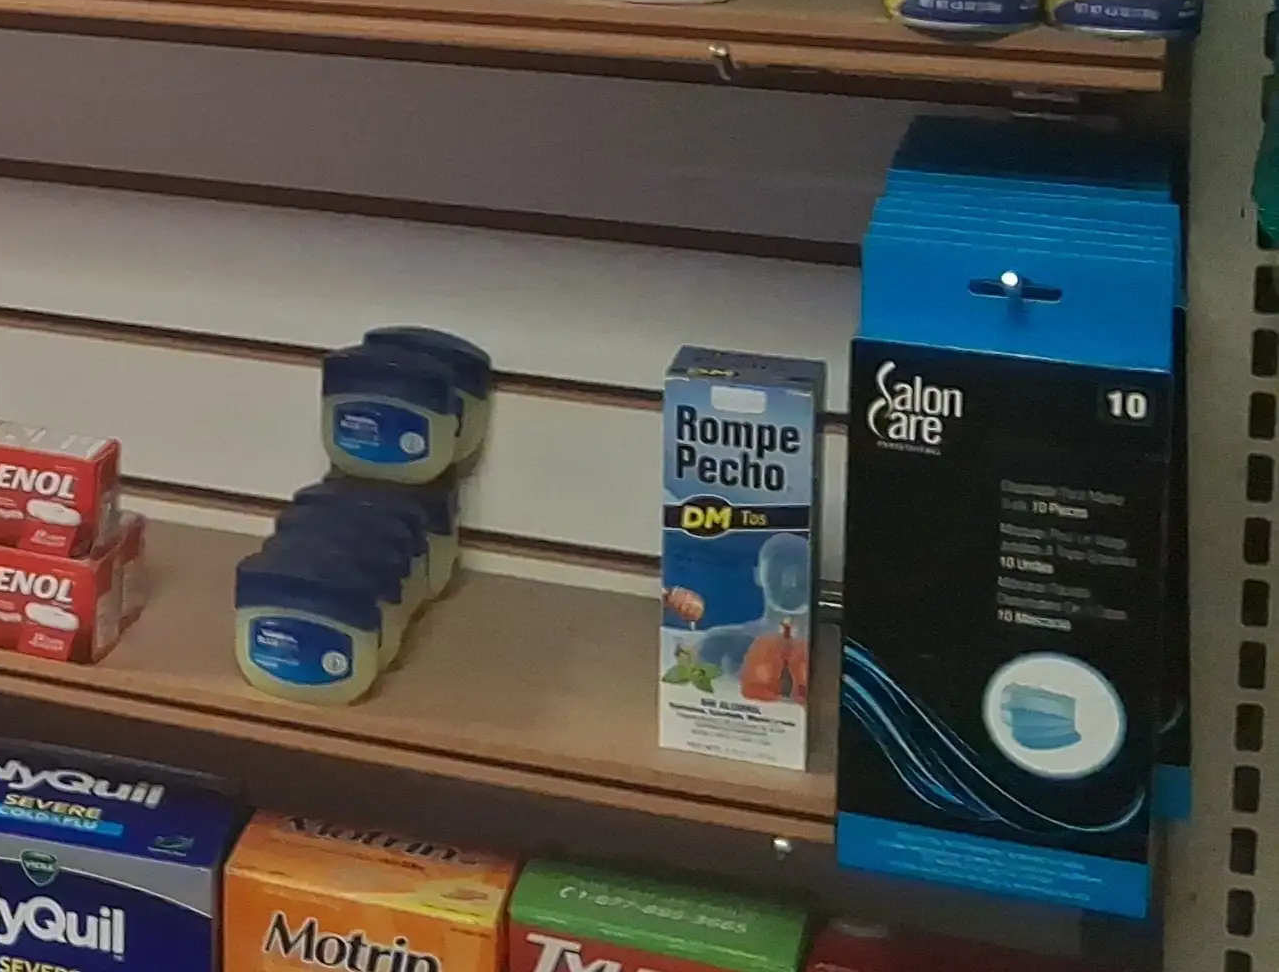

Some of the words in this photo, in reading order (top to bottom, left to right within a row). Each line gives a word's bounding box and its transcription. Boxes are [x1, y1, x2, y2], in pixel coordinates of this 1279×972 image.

[875, 361, 963, 419] Salon
[1106, 391, 1148, 420] 10
[676, 404, 802, 457] Rompe
[868, 397, 943, 446] Care
[676, 444, 786, 492] Pecho
[680, 505, 732, 530] DM
[740, 508, 768, 527] Tos
[2, 793, 103, 821] SEVERE
[262, 911, 440, 972] Motrin
